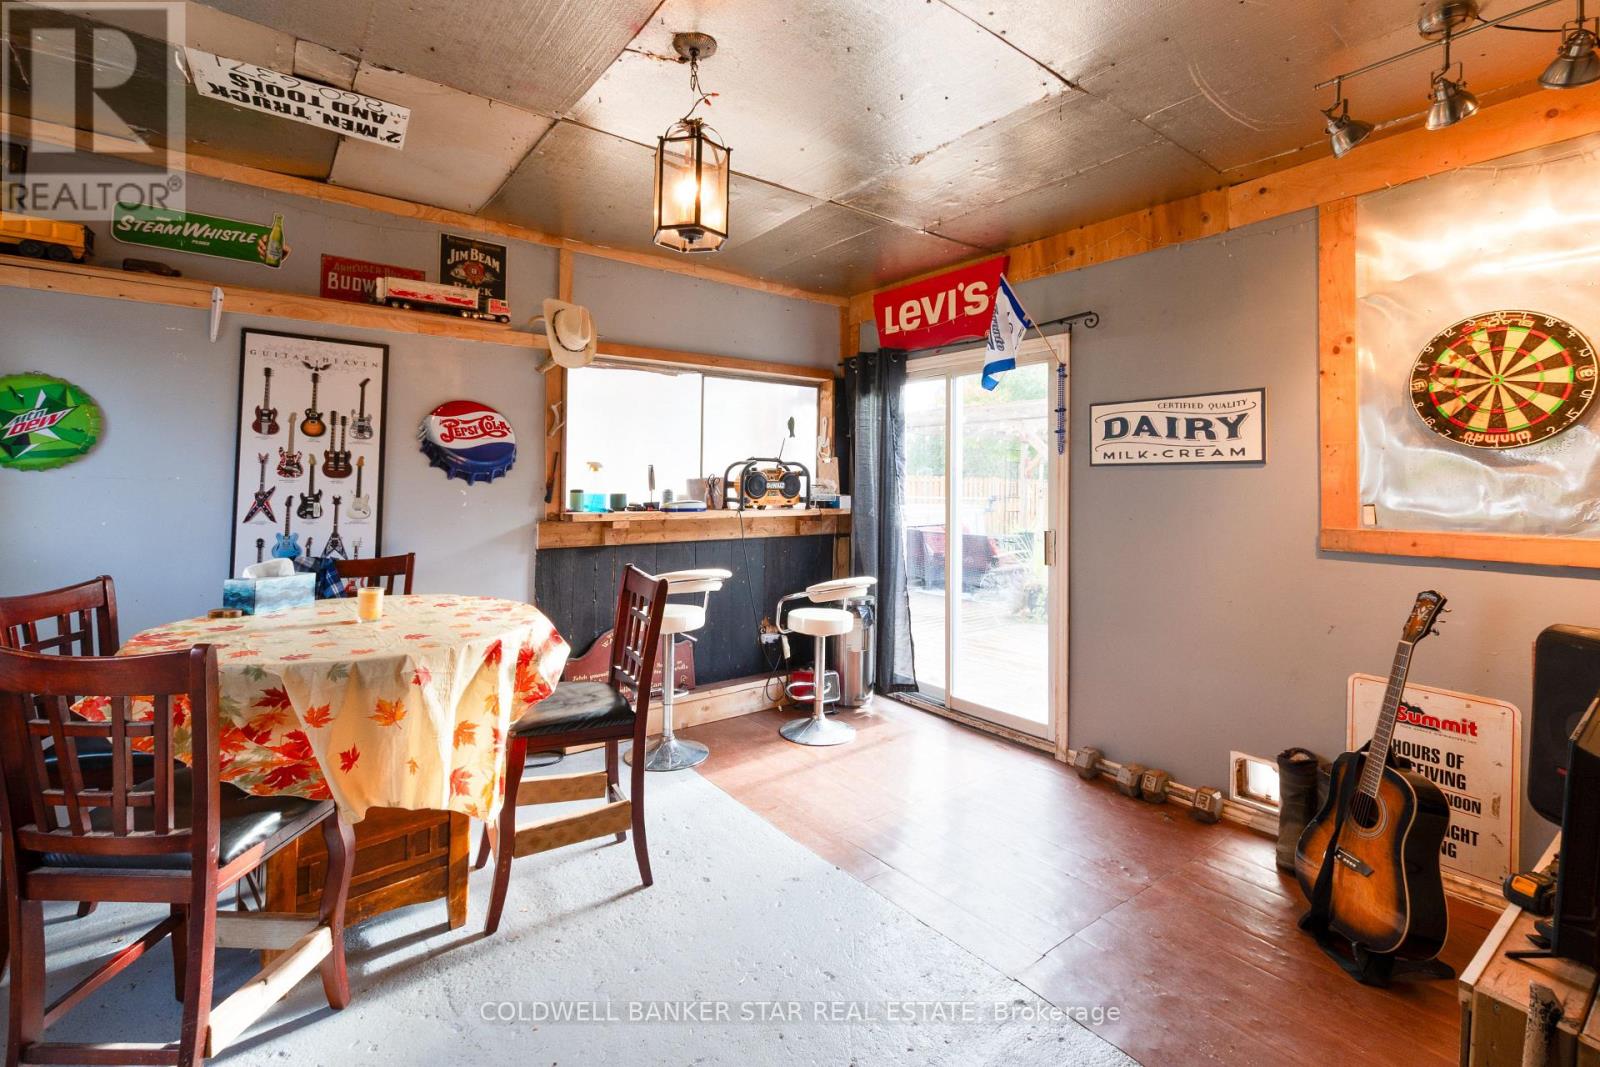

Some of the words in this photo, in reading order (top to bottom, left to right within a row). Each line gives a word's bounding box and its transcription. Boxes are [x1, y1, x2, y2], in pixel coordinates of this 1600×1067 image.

[207, 81, 311, 120] TRUCK
[229, 73, 324, 109] TOOLS
[332, 101, 387, 125] AND
[385, 130, 402, 143] 2
[447, 248, 469, 265] JIM
[470, 248, 500, 273] BEAM
[327, 271, 376, 293] BUDW
[1157, 402, 1204, 410] CERTIFIED
[1208, 399, 1248, 411] QUALITY
[1102, 413, 1249, 442] DAIRY
[1396, 705, 1478, 737] Summit
[1392, 738, 1440, 765] HOURS
[1445, 751, 1464, 770] OF
